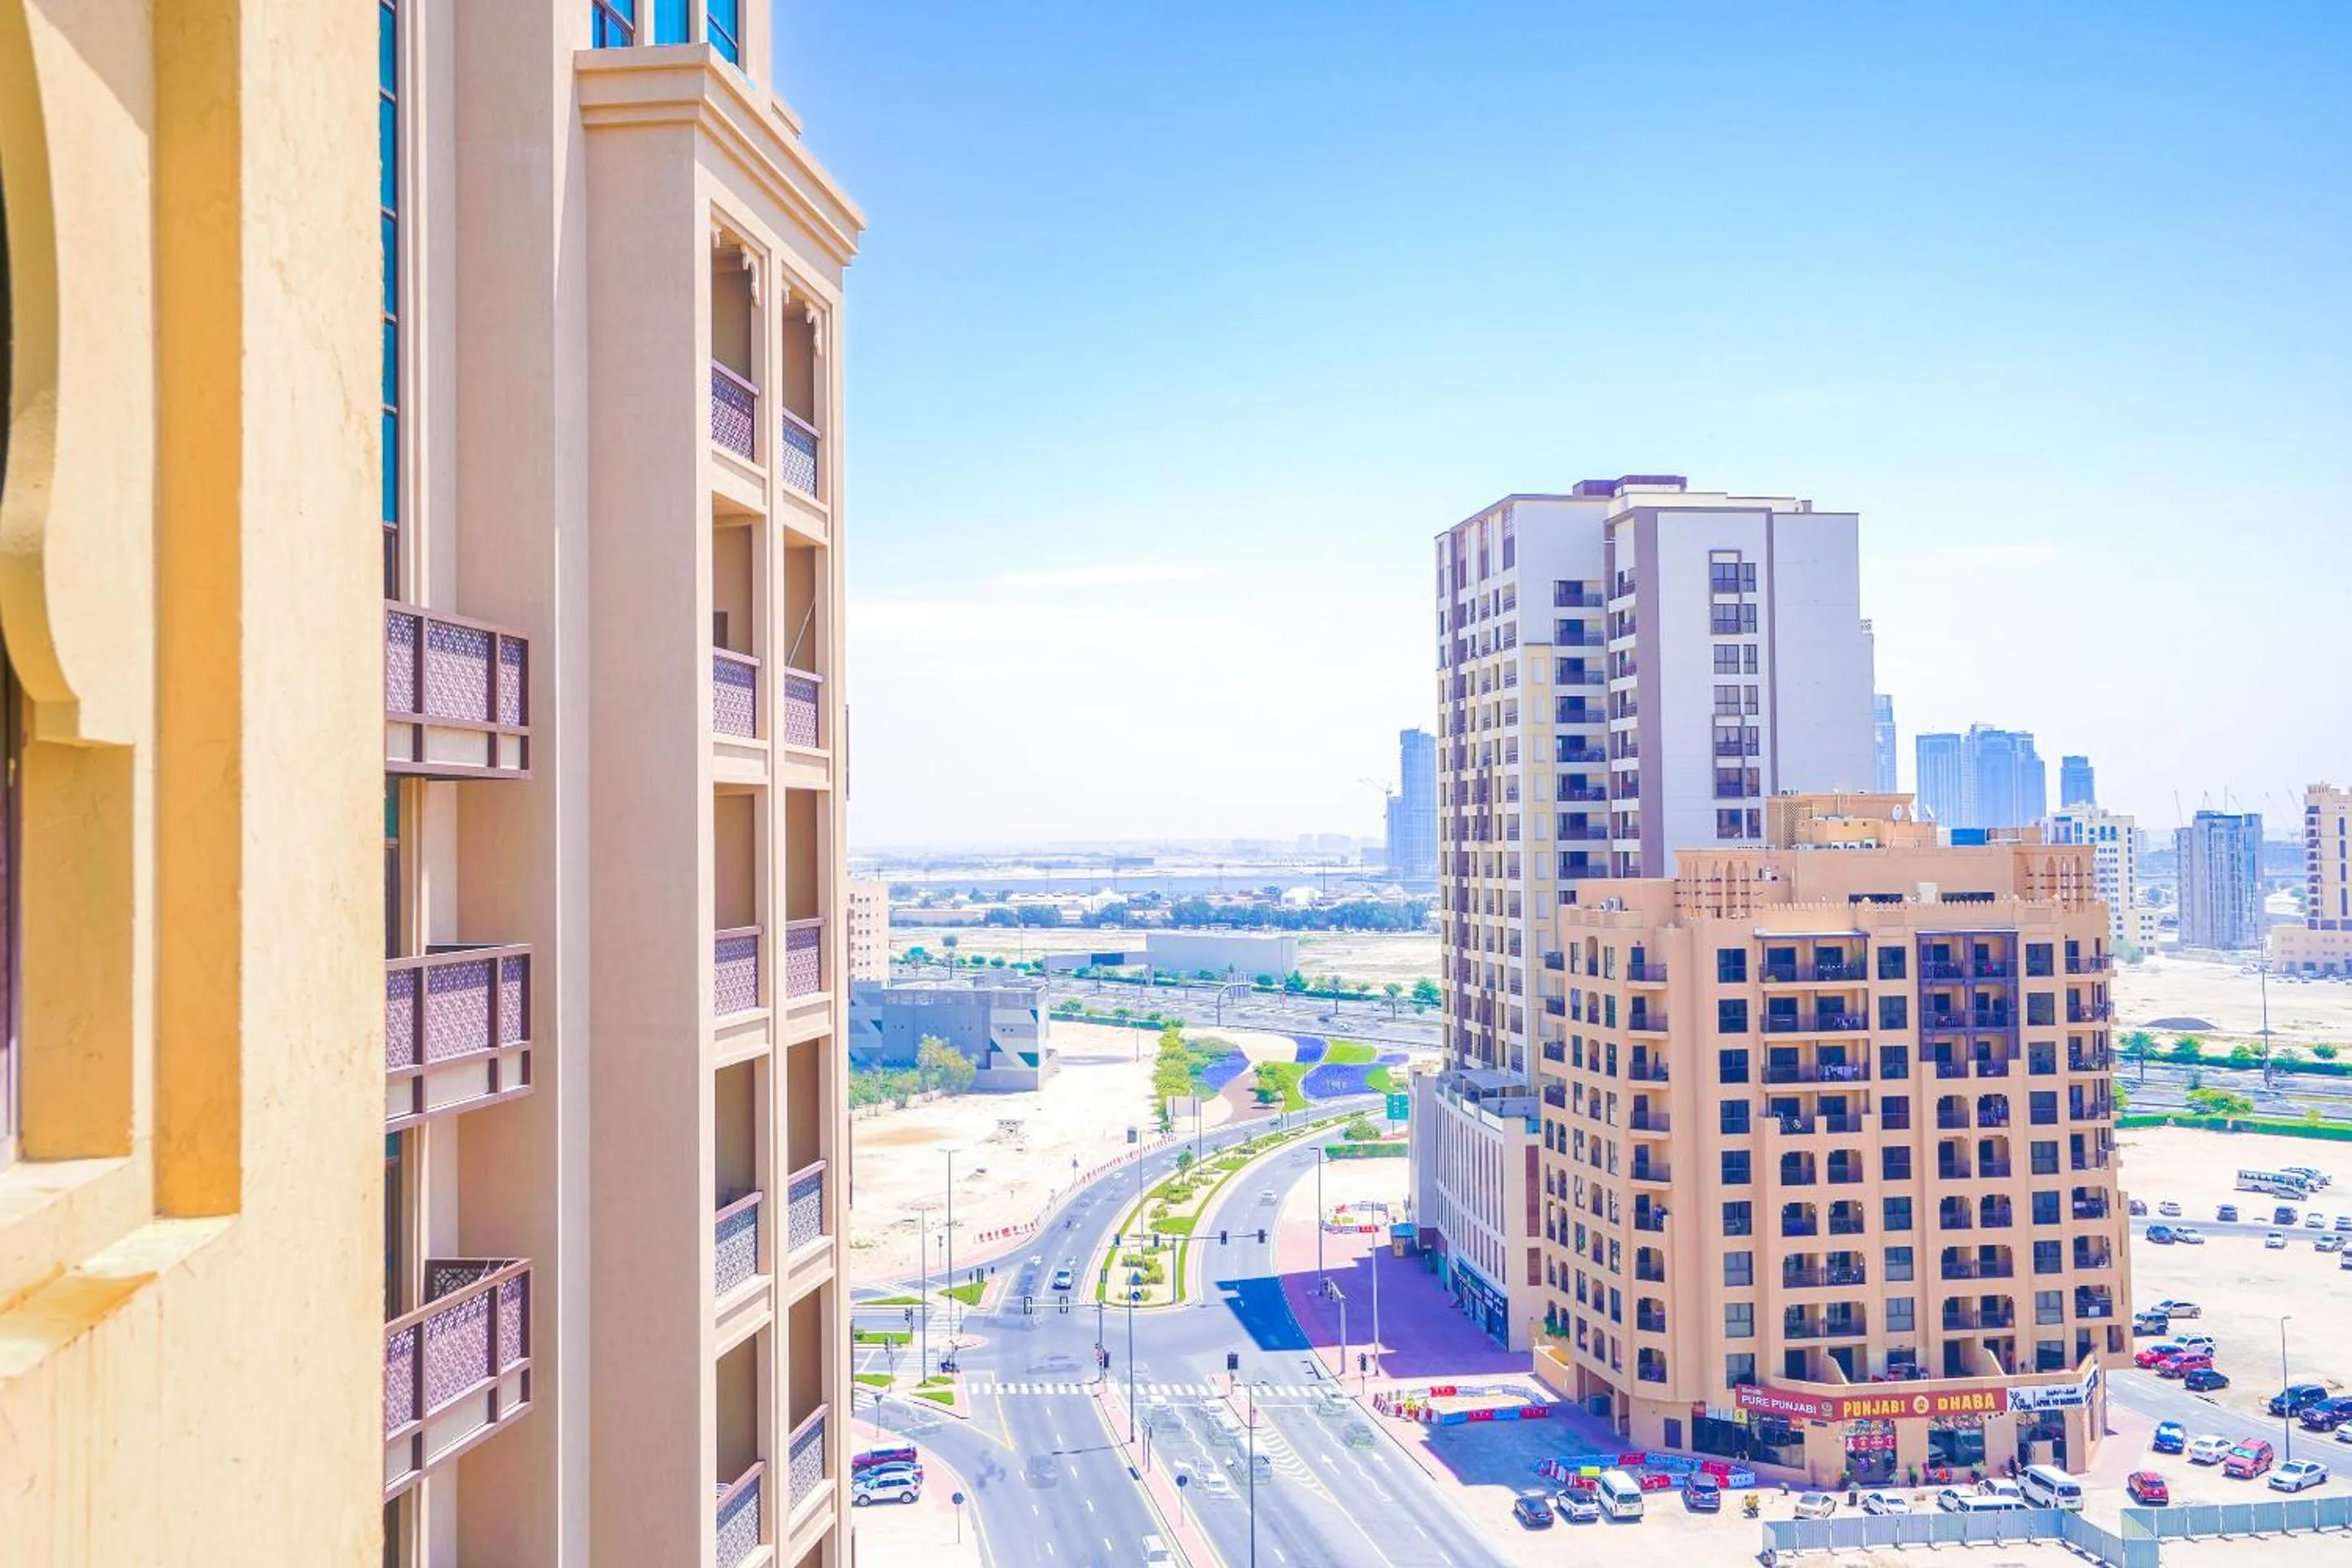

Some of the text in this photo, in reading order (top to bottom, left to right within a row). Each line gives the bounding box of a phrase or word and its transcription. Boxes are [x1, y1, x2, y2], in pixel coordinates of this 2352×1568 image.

[1741, 1395, 1817, 1415] PURE PUNJABI
[1842, 1399, 1906, 1418] PUNJABI
[1937, 1392, 1996, 1411] DHABA
